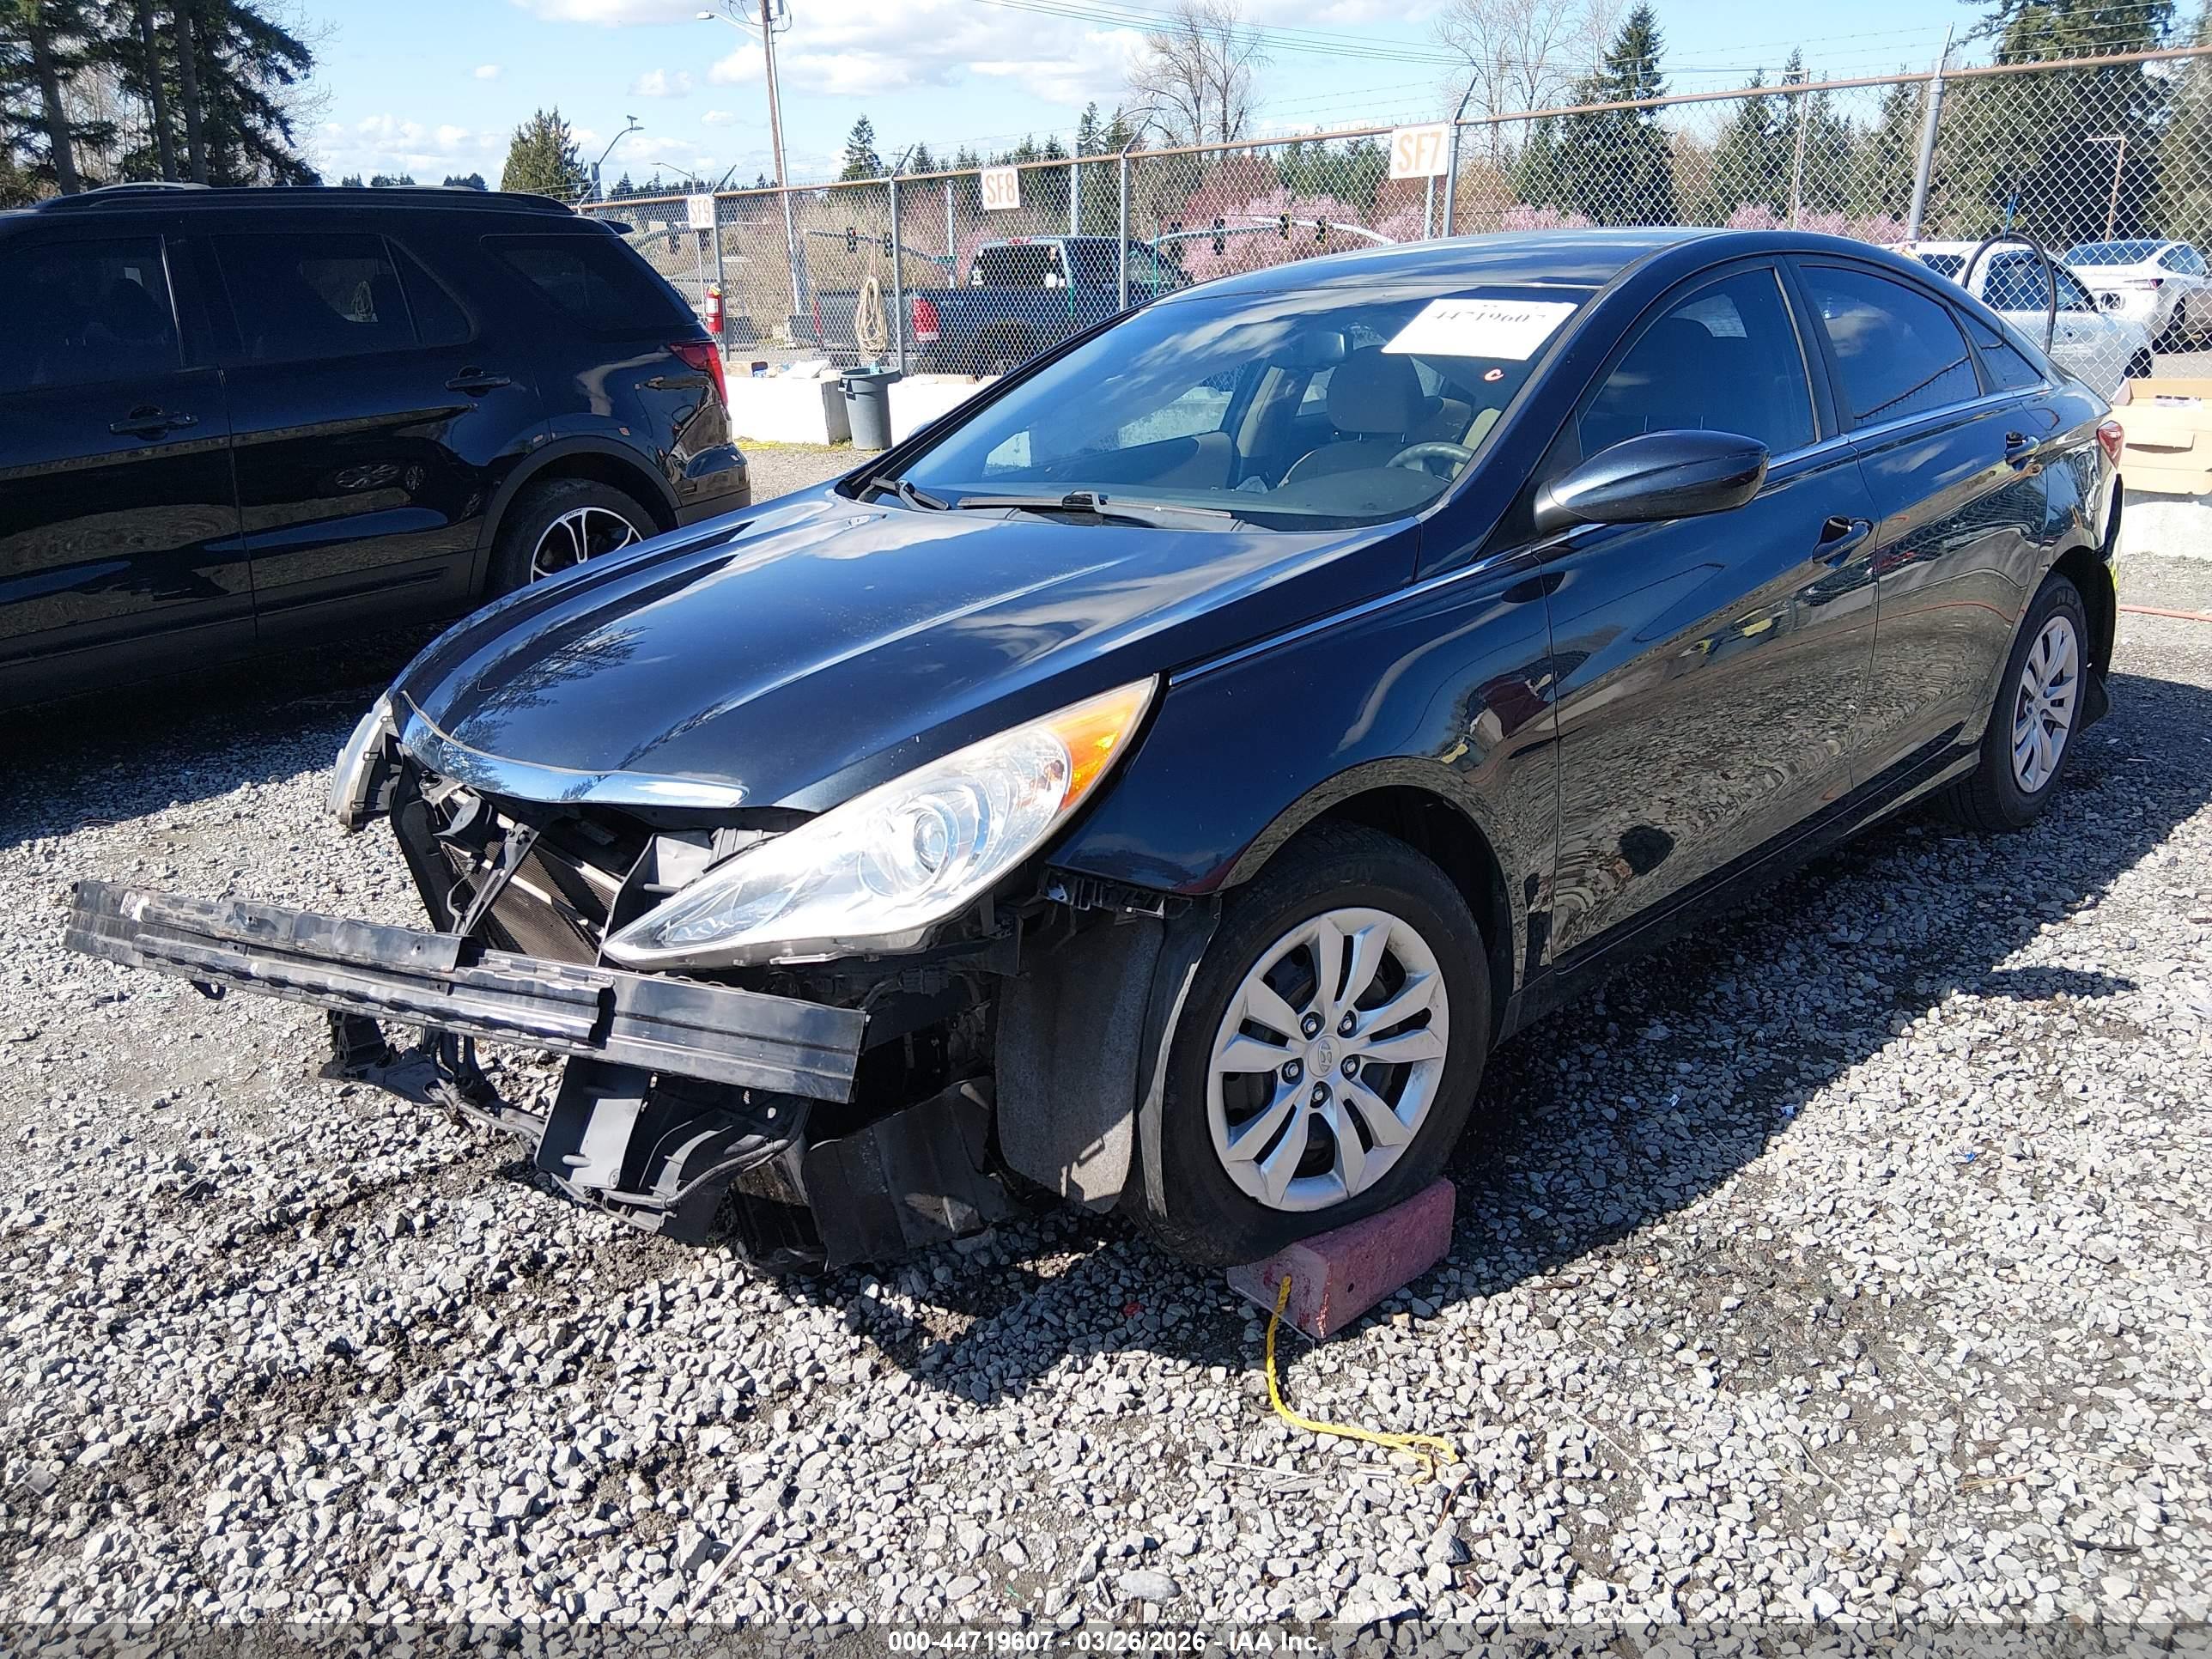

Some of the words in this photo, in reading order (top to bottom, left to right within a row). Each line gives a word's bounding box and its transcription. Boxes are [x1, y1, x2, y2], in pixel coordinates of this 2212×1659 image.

[1397, 131, 1443, 173] SF7
[986, 173, 1016, 204] SF8
[690, 199, 711, 223] SF9
